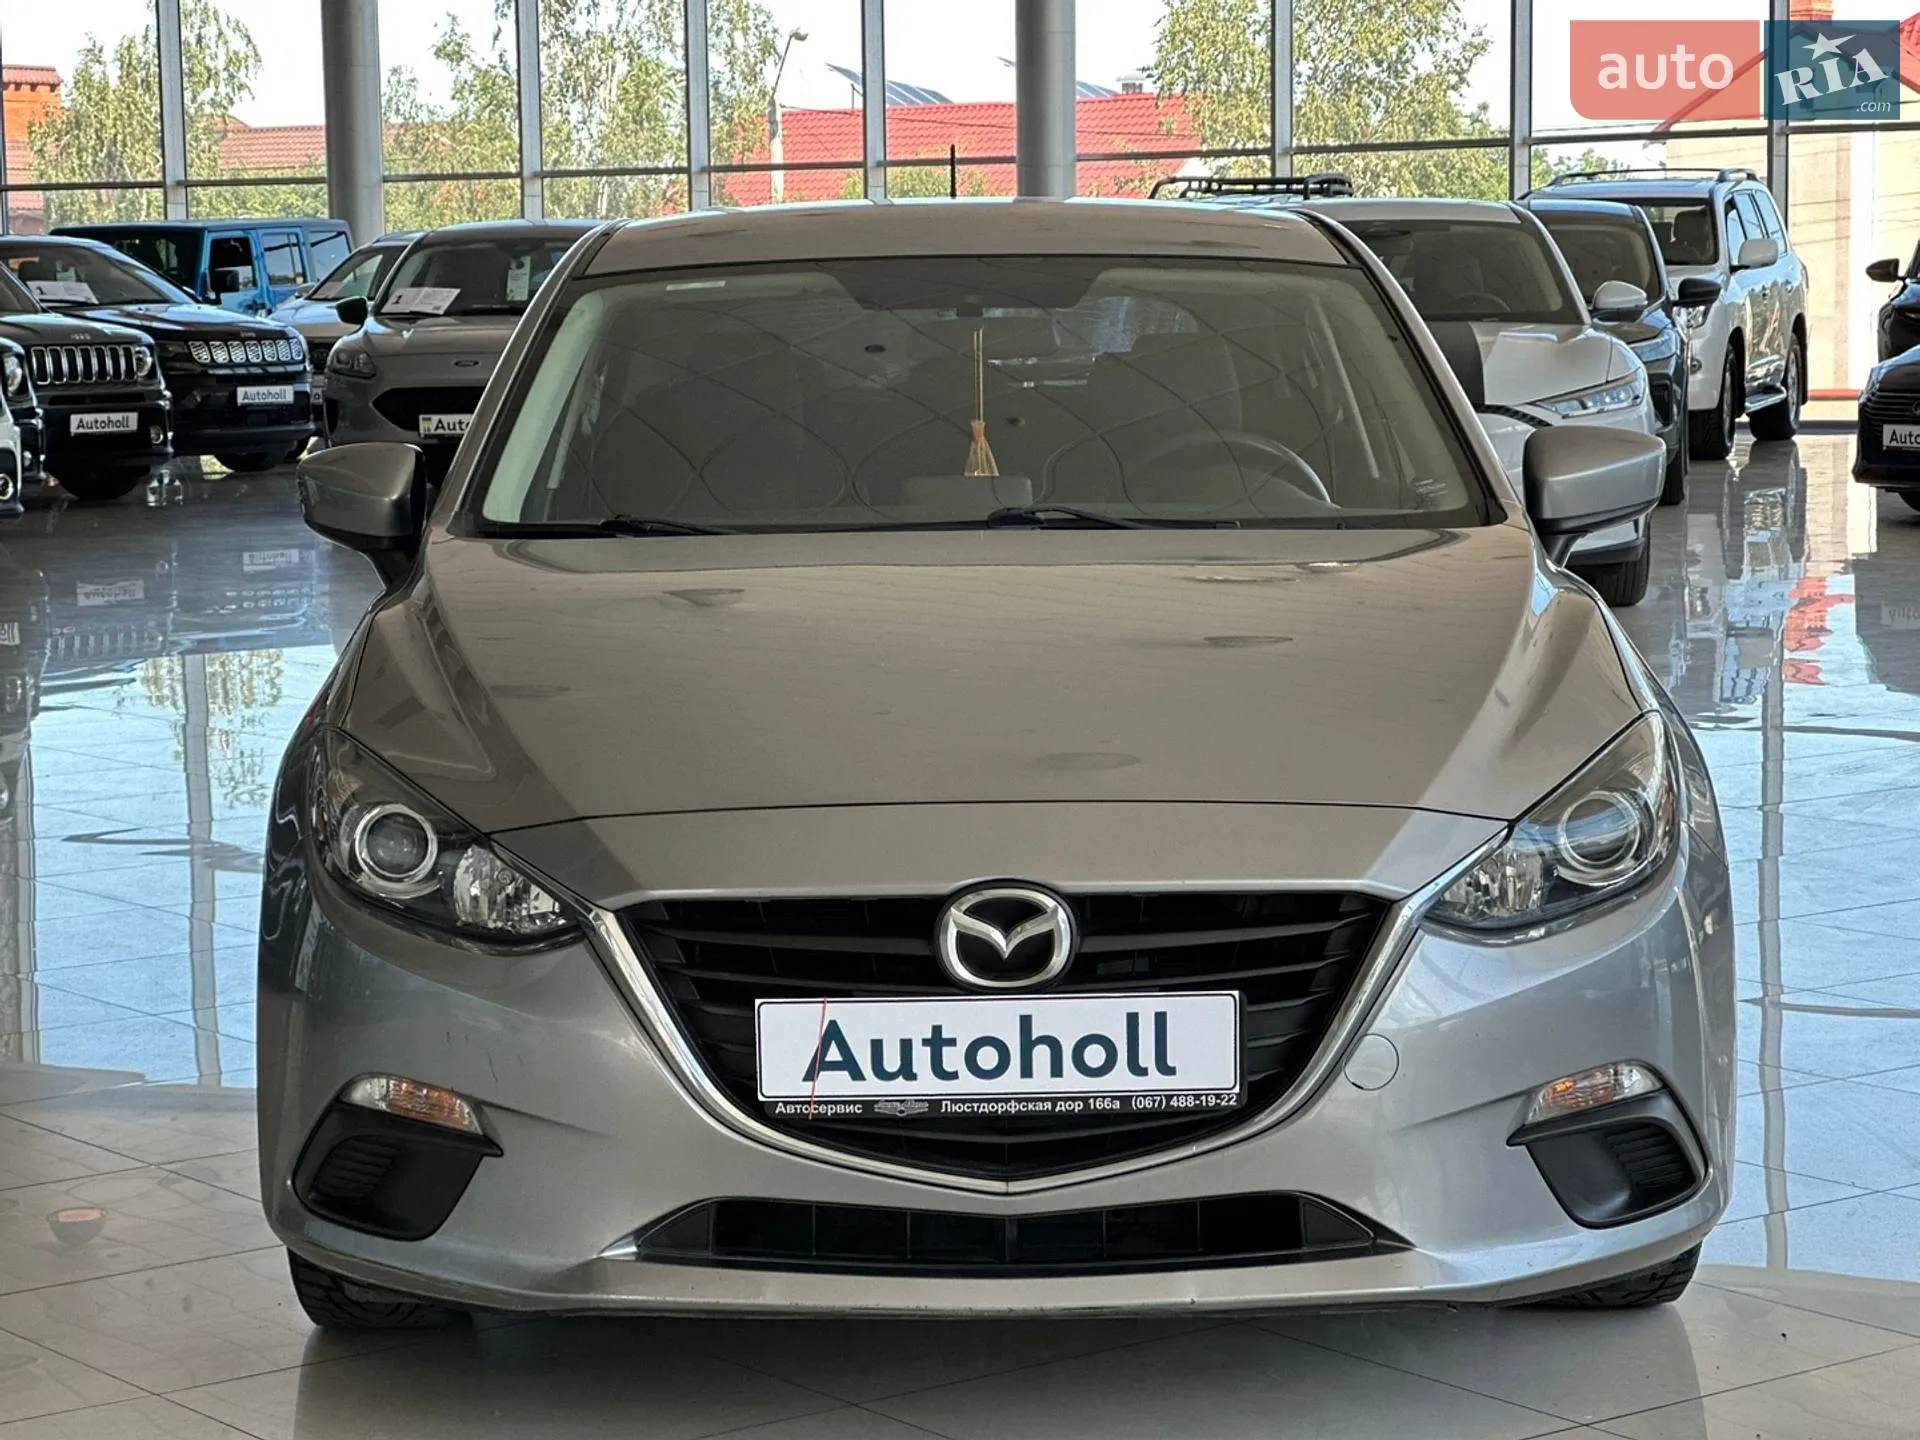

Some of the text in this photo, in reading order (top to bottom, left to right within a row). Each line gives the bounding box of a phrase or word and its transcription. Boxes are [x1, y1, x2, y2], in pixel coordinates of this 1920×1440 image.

[242, 388, 287, 401] Autoholl
[76, 415, 130, 430] Autoholl
[801, 1011, 1177, 1082] Autoholl
[775, 1102, 863, 1116] Автосервис
[940, 1098, 1052, 1115] Люстдорфская
[1055, 1100, 1084, 1114] дор
[1088, 1098, 1120, 1110] 166а
[1131, 1095, 1166, 1110] (067)
[1169, 1094, 1237, 1108] 488-19-22
